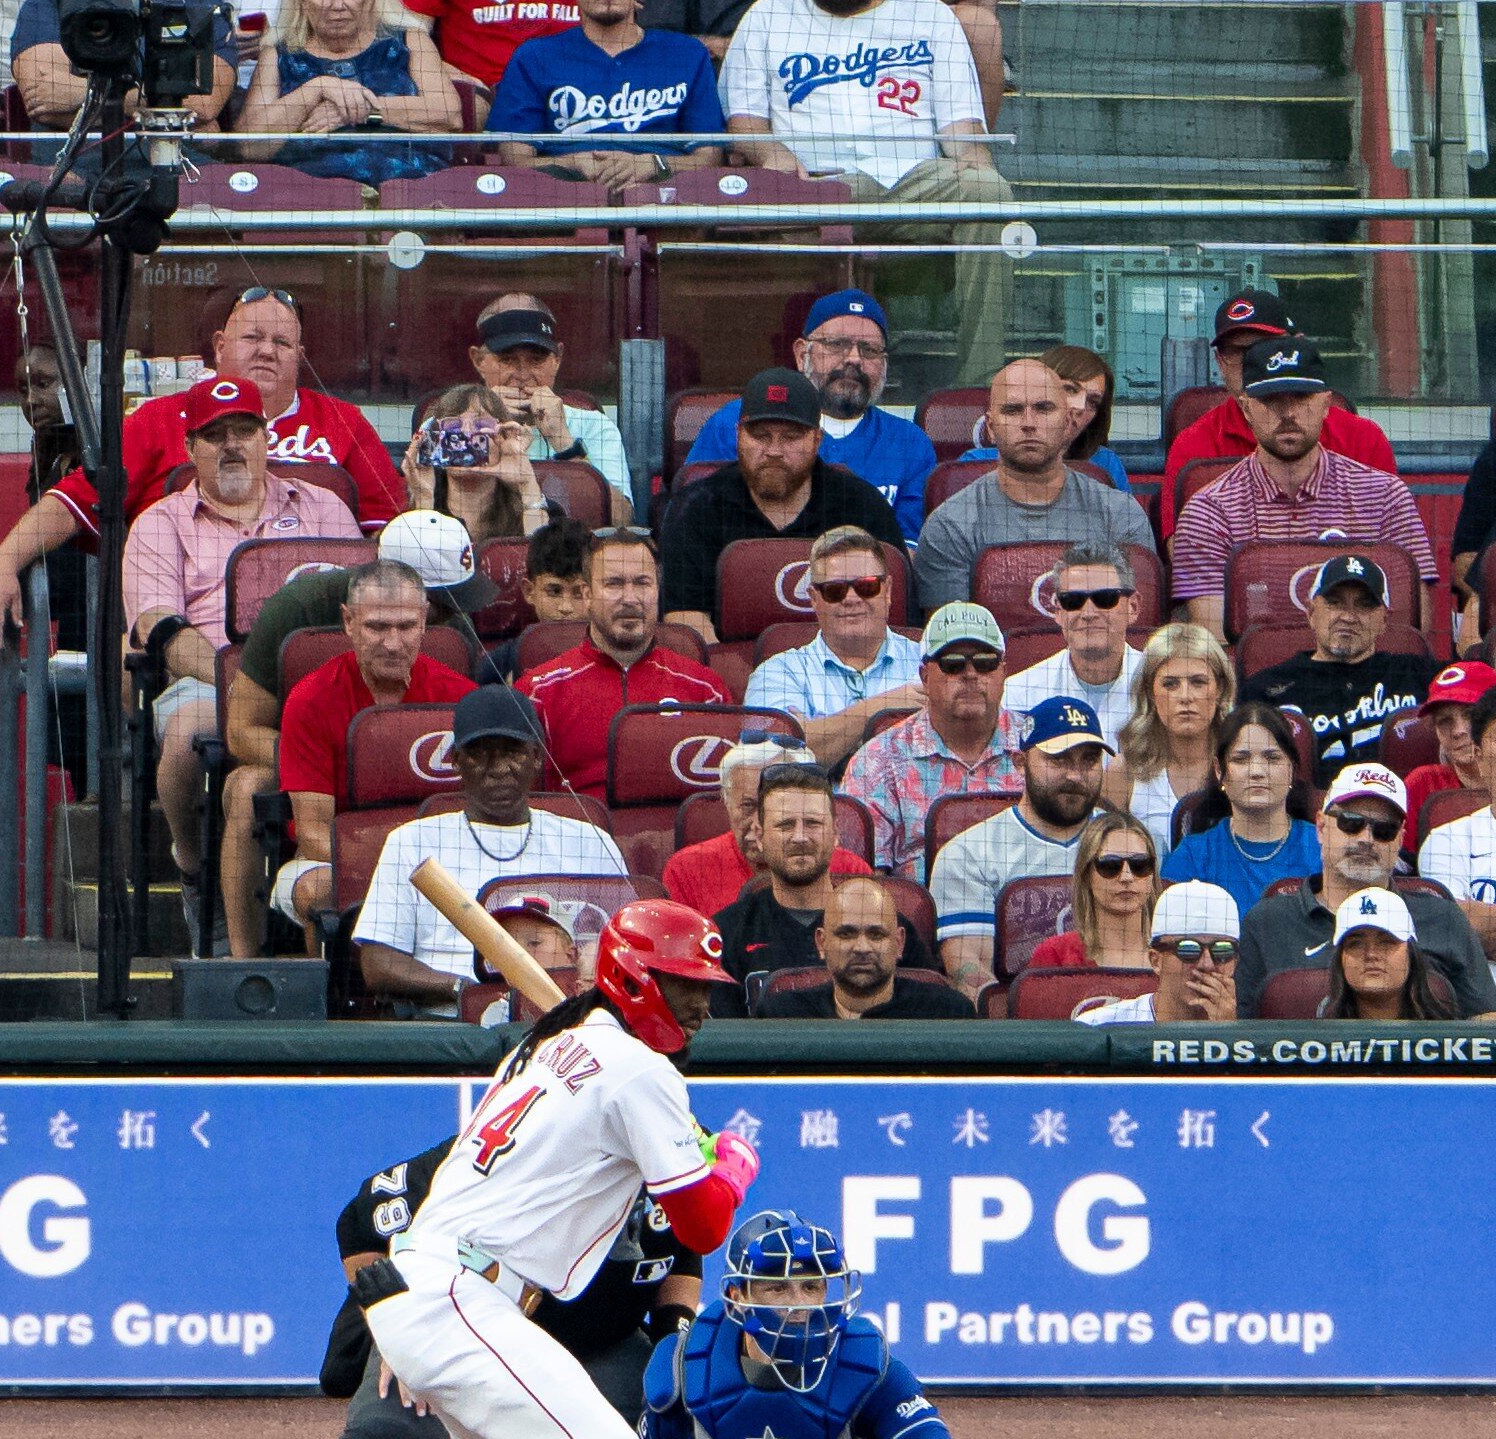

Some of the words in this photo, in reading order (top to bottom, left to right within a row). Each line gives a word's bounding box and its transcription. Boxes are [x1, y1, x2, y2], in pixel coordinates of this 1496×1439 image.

[472, 3, 514, 25] BUILT
[518, 2, 549, 20] FOR
[552, 3, 581, 22] FALL
[778, 39, 933, 108] Dodgers
[549, 80, 689, 134] Dodgers
[876, 78, 919, 117] 22
[1227, 300, 1255, 319] C
[210, 380, 240, 401] C
[266, 416, 334, 462] eds
[1345, 556, 1365, 576] LA
[961, 611, 989, 627] POLY
[1435, 667, 1467, 686] C
[1064, 704, 1087, 728] LA
[1354, 768, 1398, 794] Reds
[1360, 894, 1378, 915] LA
[699, 932, 723, 960] C
[461, 1068, 548, 1177] 4
[726, 1109, 1273, 1151] 金融で未来を拓く
[840, 1173, 1152, 1276] FPG
[112, 1303, 275, 1356] Group
[925, 1300, 1154, 1347] Partners
[1171, 1301, 1334, 1353] Group
